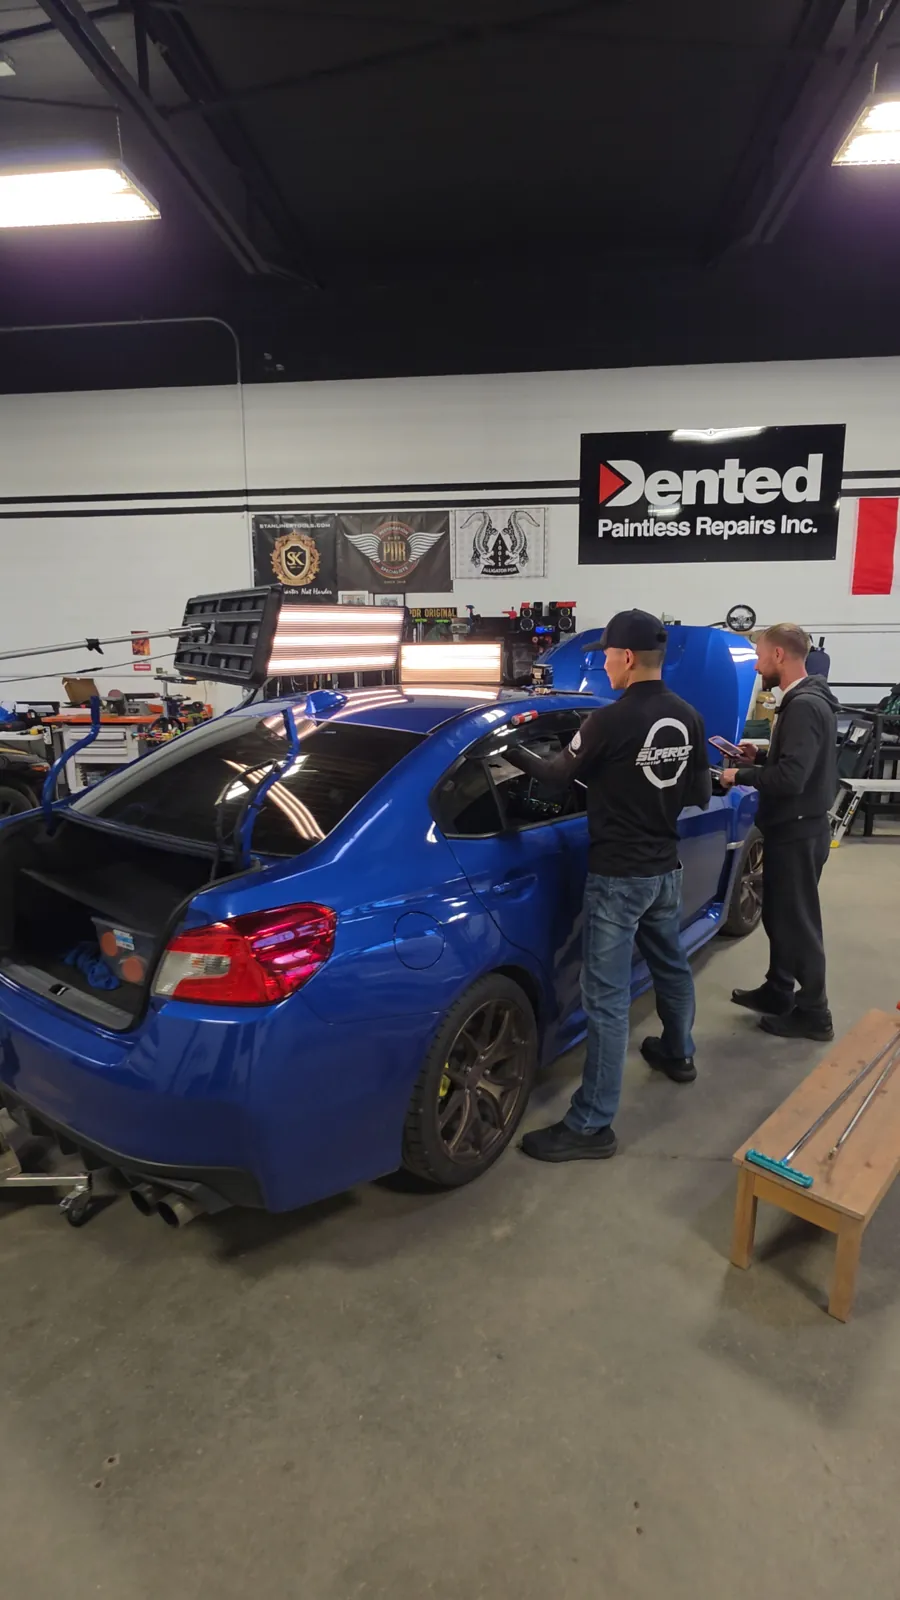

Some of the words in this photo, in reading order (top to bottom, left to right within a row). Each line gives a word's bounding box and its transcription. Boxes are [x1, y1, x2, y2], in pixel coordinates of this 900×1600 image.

[604, 453, 824, 507] Dented
[598, 518, 691, 538] Paintless
[696, 516, 776, 540] Repairs
[781, 514, 818, 534] Inc.
[382, 541, 406, 562] PDR
[424, 607, 457, 618] ORIGINAL
